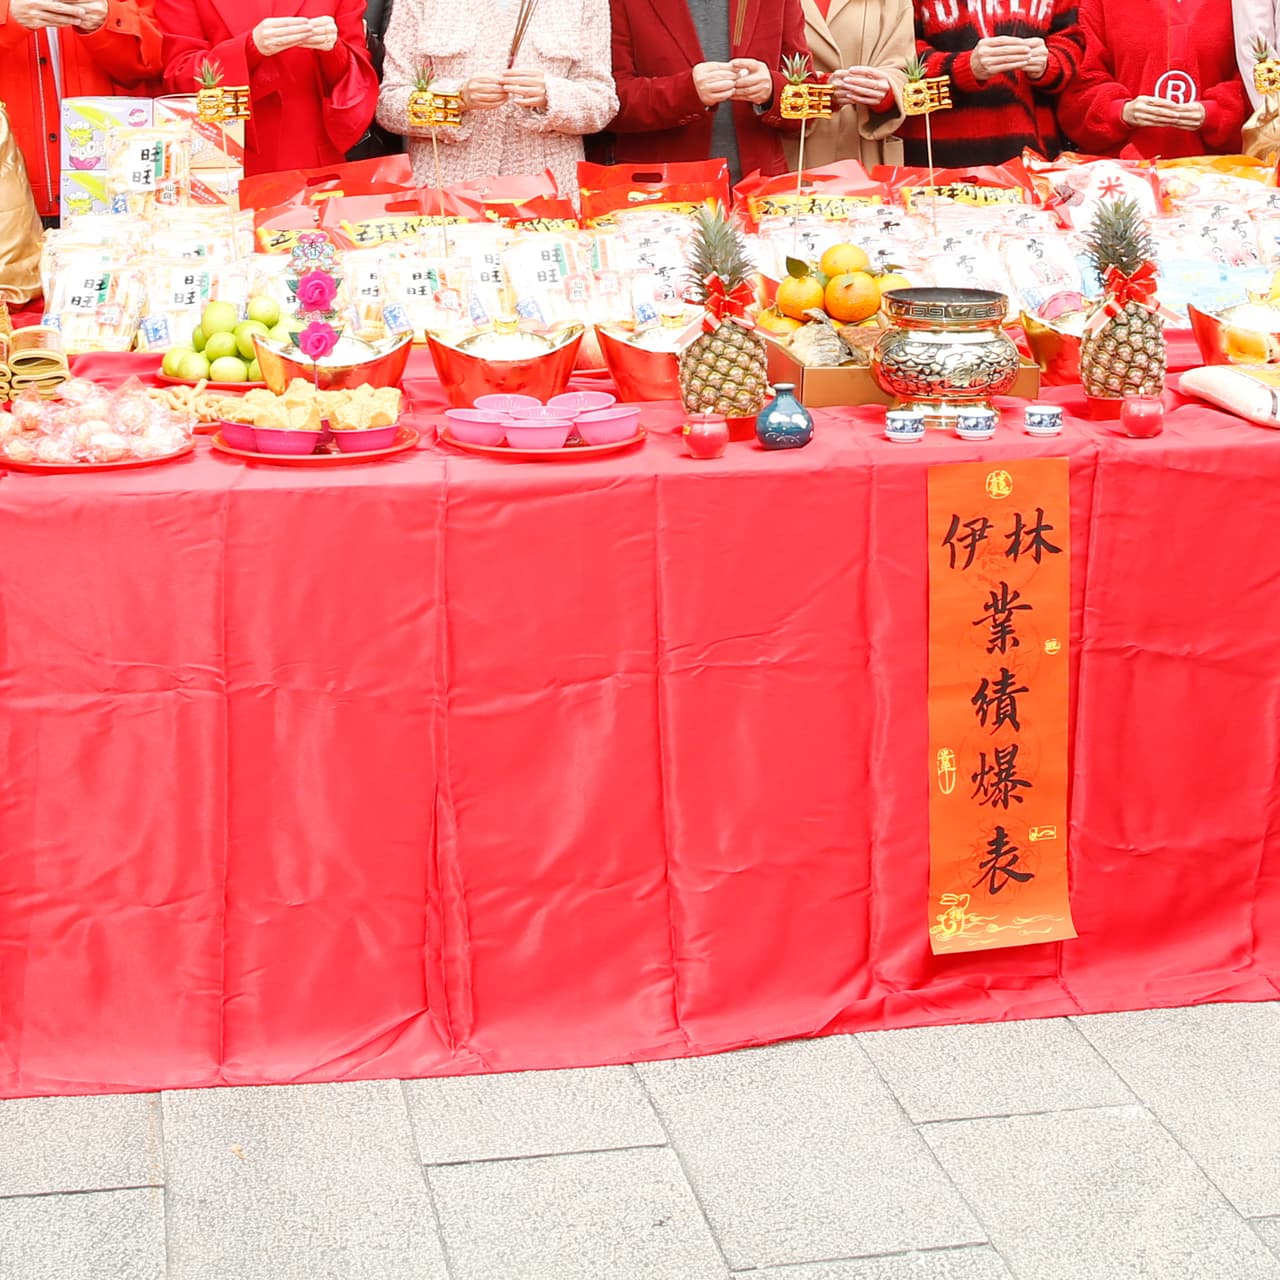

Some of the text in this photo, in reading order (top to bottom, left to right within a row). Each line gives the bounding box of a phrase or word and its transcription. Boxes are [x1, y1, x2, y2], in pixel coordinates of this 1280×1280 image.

[941, 507, 1064, 570] 伊林
[971, 582, 1036, 896] 業績爆表
